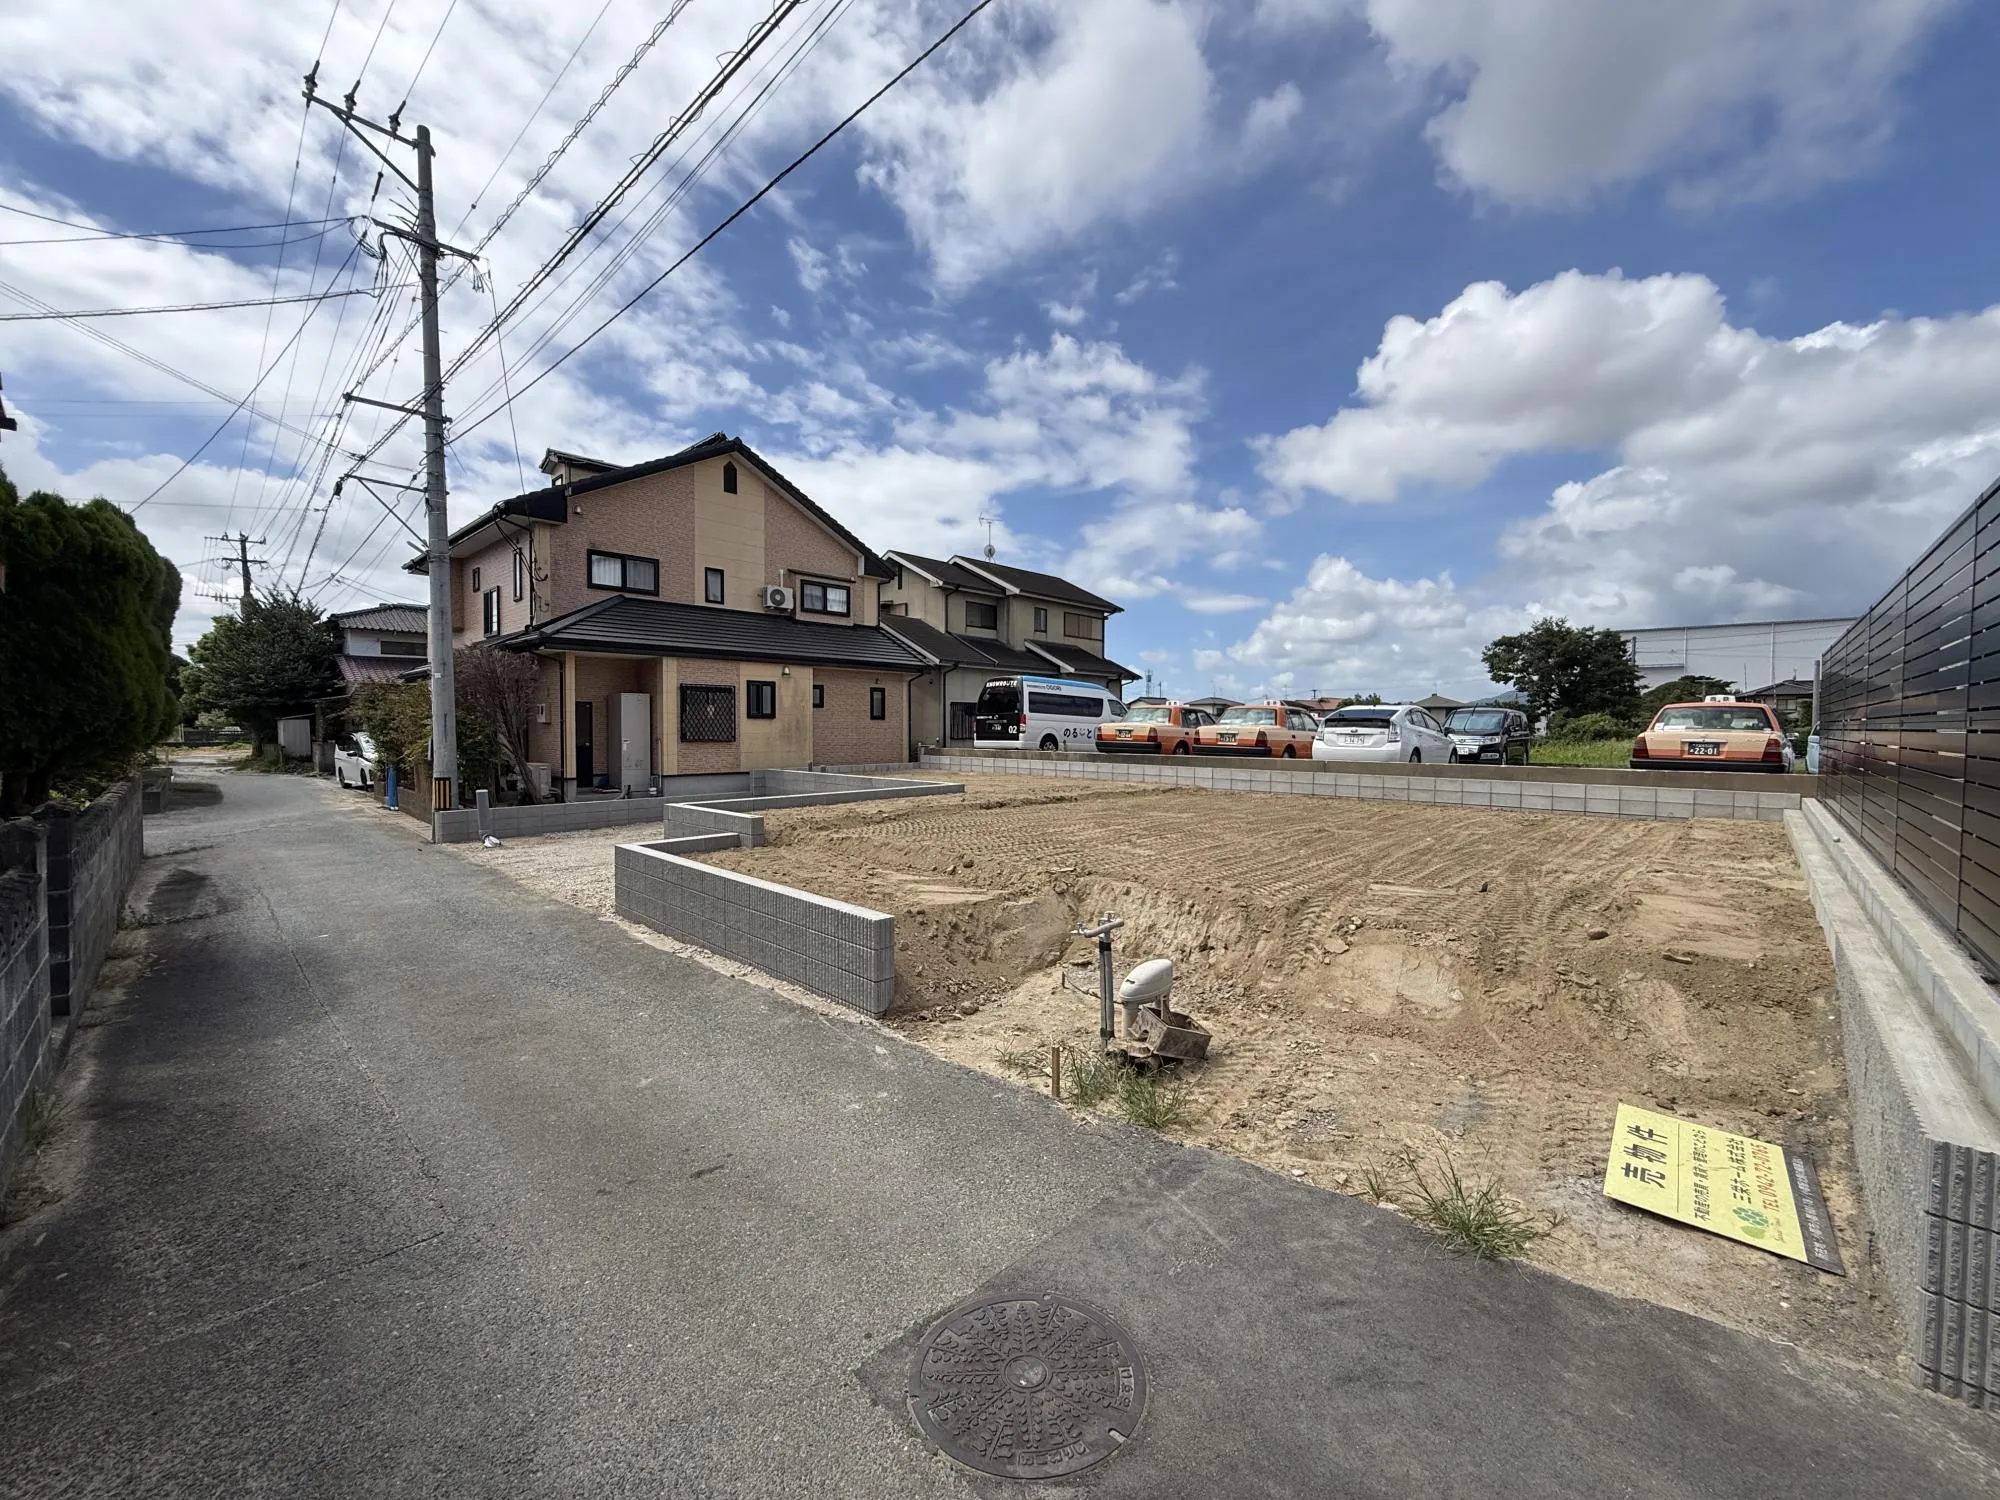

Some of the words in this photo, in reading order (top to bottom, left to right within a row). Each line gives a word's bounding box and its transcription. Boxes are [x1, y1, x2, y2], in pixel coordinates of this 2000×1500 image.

[1008, 725, 1018, 734] 02
[1621, 1125, 1668, 1188] 売物件
